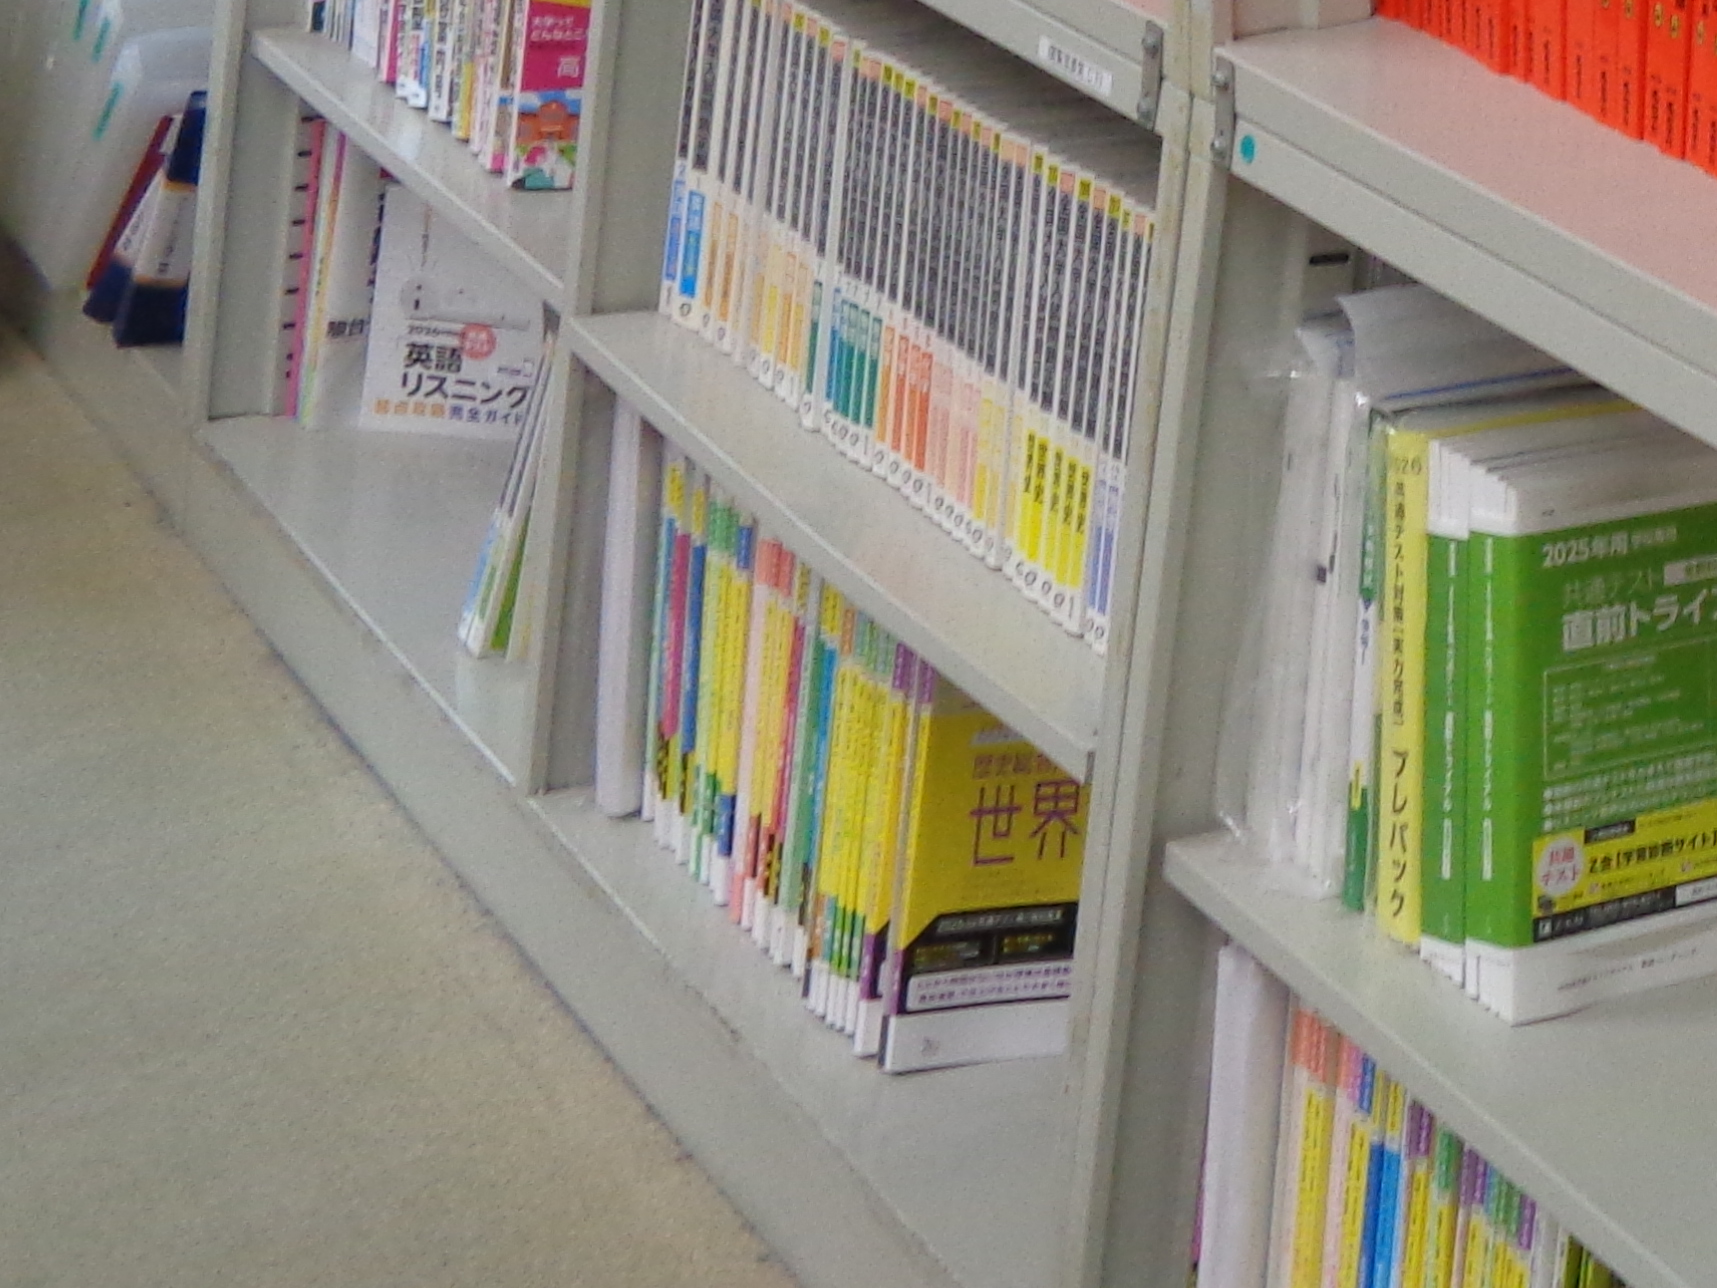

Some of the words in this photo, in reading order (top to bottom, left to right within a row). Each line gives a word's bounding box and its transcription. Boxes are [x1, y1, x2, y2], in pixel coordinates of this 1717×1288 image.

[404, 341, 463, 375] 英語
[400, 371, 531, 410] リスニング
[1390, 749, 1410, 919] プレパック
